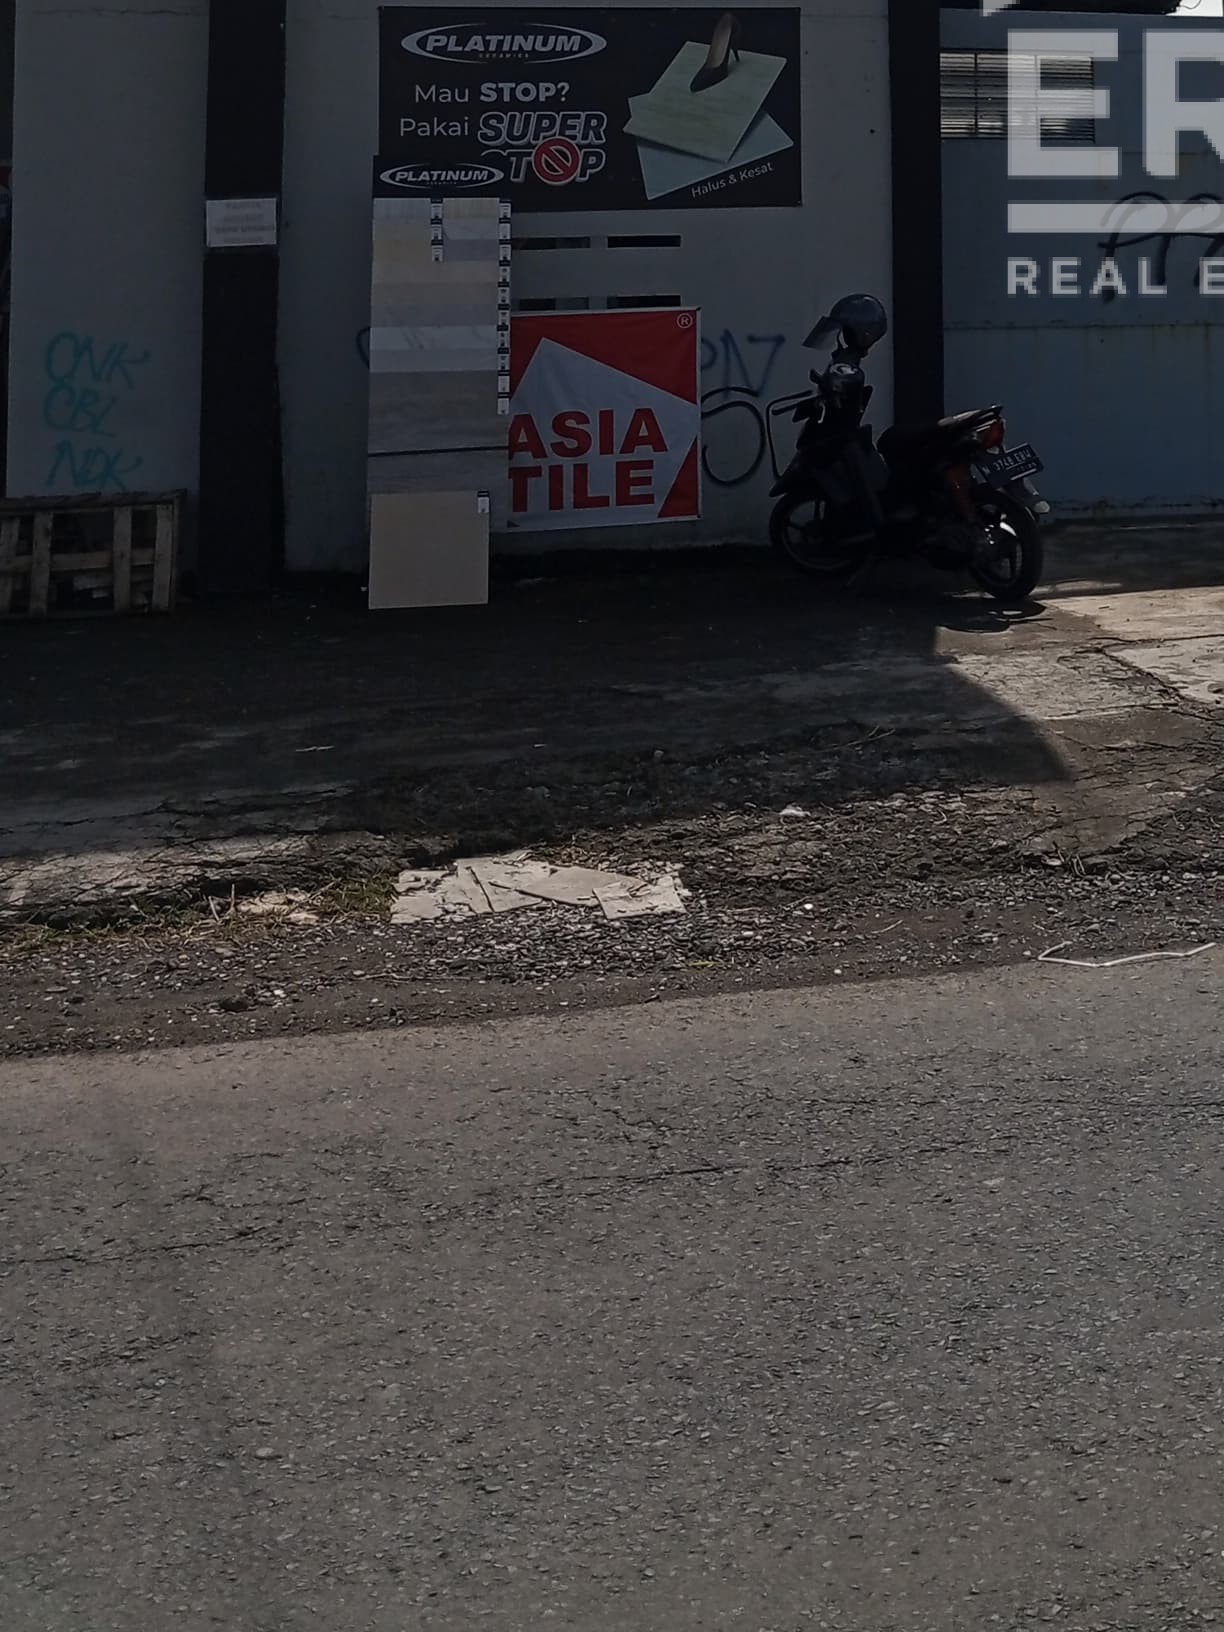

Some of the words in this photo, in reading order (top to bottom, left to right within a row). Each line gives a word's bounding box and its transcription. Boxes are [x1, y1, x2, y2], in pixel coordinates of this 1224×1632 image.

[425, 34, 582, 52] PLATINUM
[414, 84, 470, 103] Mau
[479, 82, 570, 103] STOP?
[400, 116, 470, 137] Pakai
[477, 111, 608, 146] SUPER
[394, 169, 490, 182] PLATINUM
[480, 137, 607, 186] TOP
[690, 178, 727, 199] Halus
[728, 173, 738, 185] &
[739, 161, 775, 182] Kesat
[507, 407, 668, 460] ASIA
[507, 459, 656, 514] TILE
